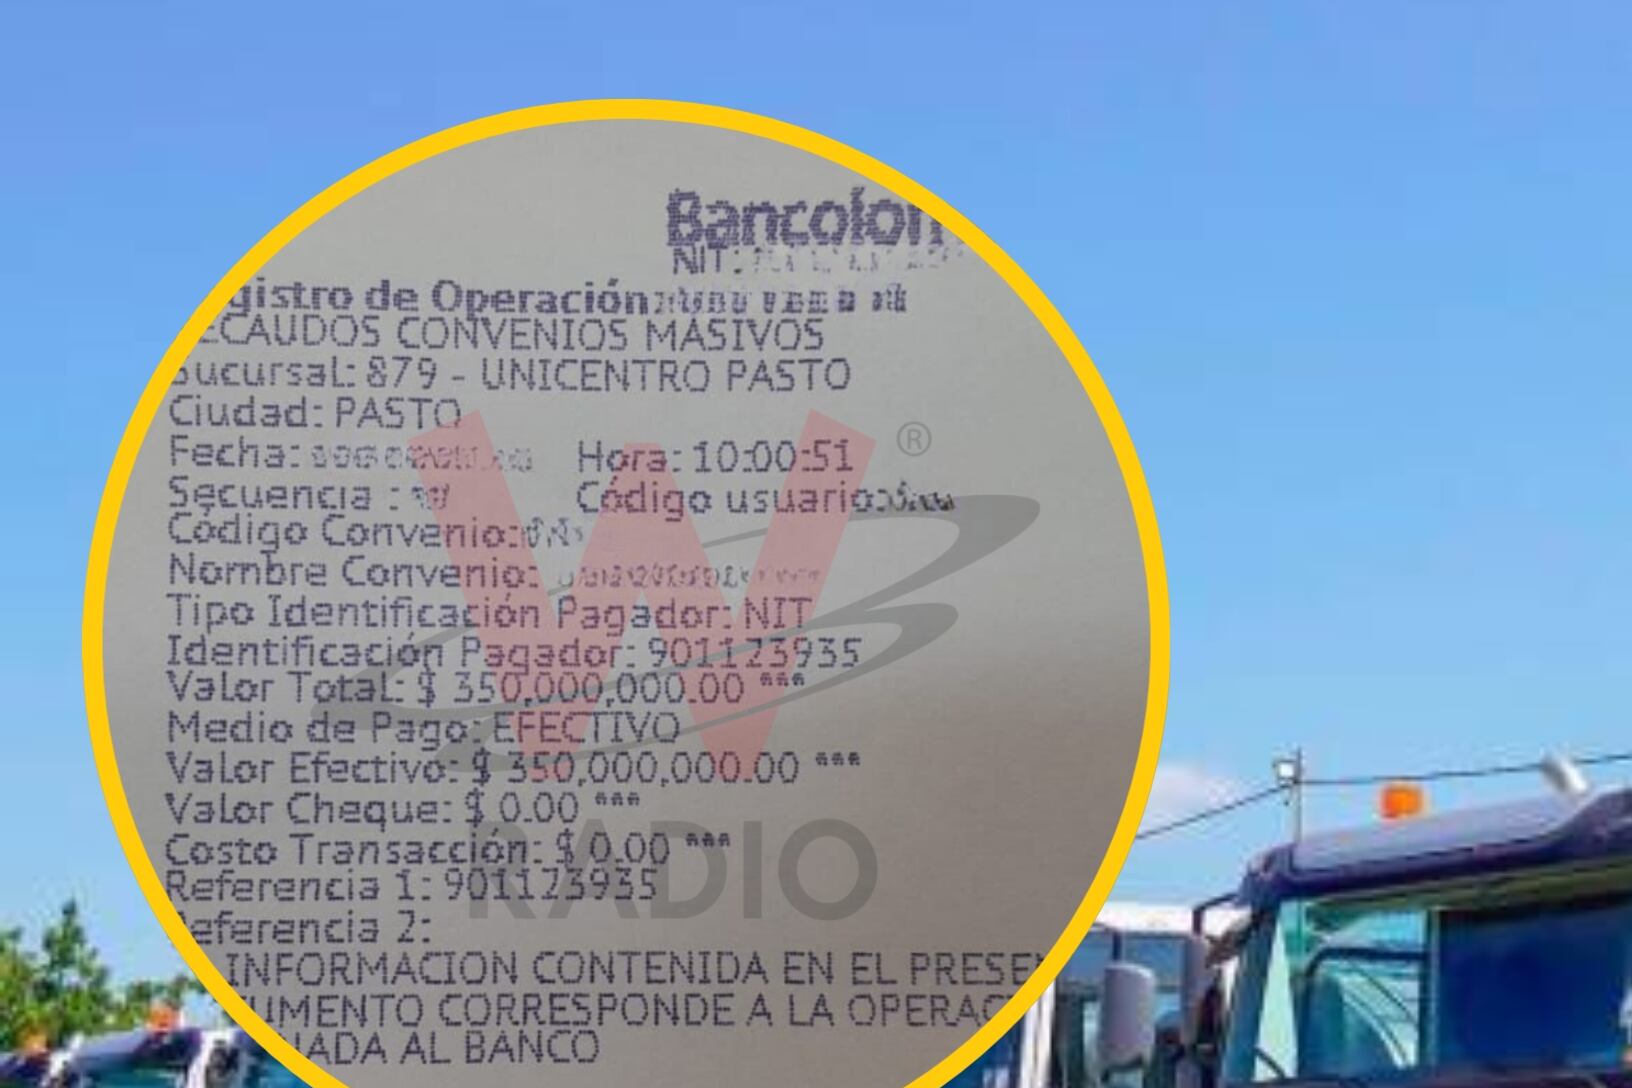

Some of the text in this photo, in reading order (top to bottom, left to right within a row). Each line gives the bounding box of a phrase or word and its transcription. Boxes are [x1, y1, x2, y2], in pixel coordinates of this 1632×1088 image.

[366, 280, 418, 312] de
[398, 320, 628, 350] CONVENIOS
[647, 319, 823, 350] MASIVOS
[367, 357, 437, 388] 879
[482, 359, 710, 390] UNICENTRO
[728, 359, 851, 390] PASTO
[169, 395, 462, 428] Ciudad: PASTO
[170, 437, 298, 468] Fecha:
[579, 440, 682, 472] Hora:
[694, 438, 853, 472] 10:00:51
[169, 477, 372, 511] Secuencia
[578, 475, 712, 522] Código
[168, 507, 308, 553] Código
[169, 551, 326, 587] Nombre
[342, 555, 538, 588] Convenio:
[166, 589, 811, 635] Tipo Identificación Pagador: NIT
[168, 632, 861, 673] Identificación Pagador: 901123935
[168, 670, 274, 702] Valor
[288, 670, 403, 702] Total:
[418, 670, 435, 707] $
[453, 670, 744, 707] 350,000,000.00
[169, 711, 680, 751] Medio de Pago: EFECTIVO
[168, 752, 274, 783] Valor
[290, 751, 458, 783] Efectivo:
[473, 748, 492, 787] $
[508, 751, 799, 787] 350,000,000.00
[166, 793, 274, 823] Valor
[288, 793, 452, 832] Cheque:
[466, 788, 484, 827] $
[499, 792, 578, 823] 0.00
[166, 833, 277, 864] Costo
[289, 828, 542, 864] Transacción:
[556, 830, 574, 868] $
[590, 832, 670, 864] 0.00
[166, 868, 657, 901] Referencia 1: 901123935
[176, 909, 431, 944] eferencia 2:
[227, 952, 518, 986] INFORMACION
[533, 951, 768, 985] CONTENIDA
[783, 952, 833, 984] EN
[852, 952, 897, 984] EL
[239, 995, 1015, 1026] UMENTO CORRESPONDE A LA OPERAC
[400, 1032, 450, 1064] AL
[465, 1031, 600, 1064] BANCO
